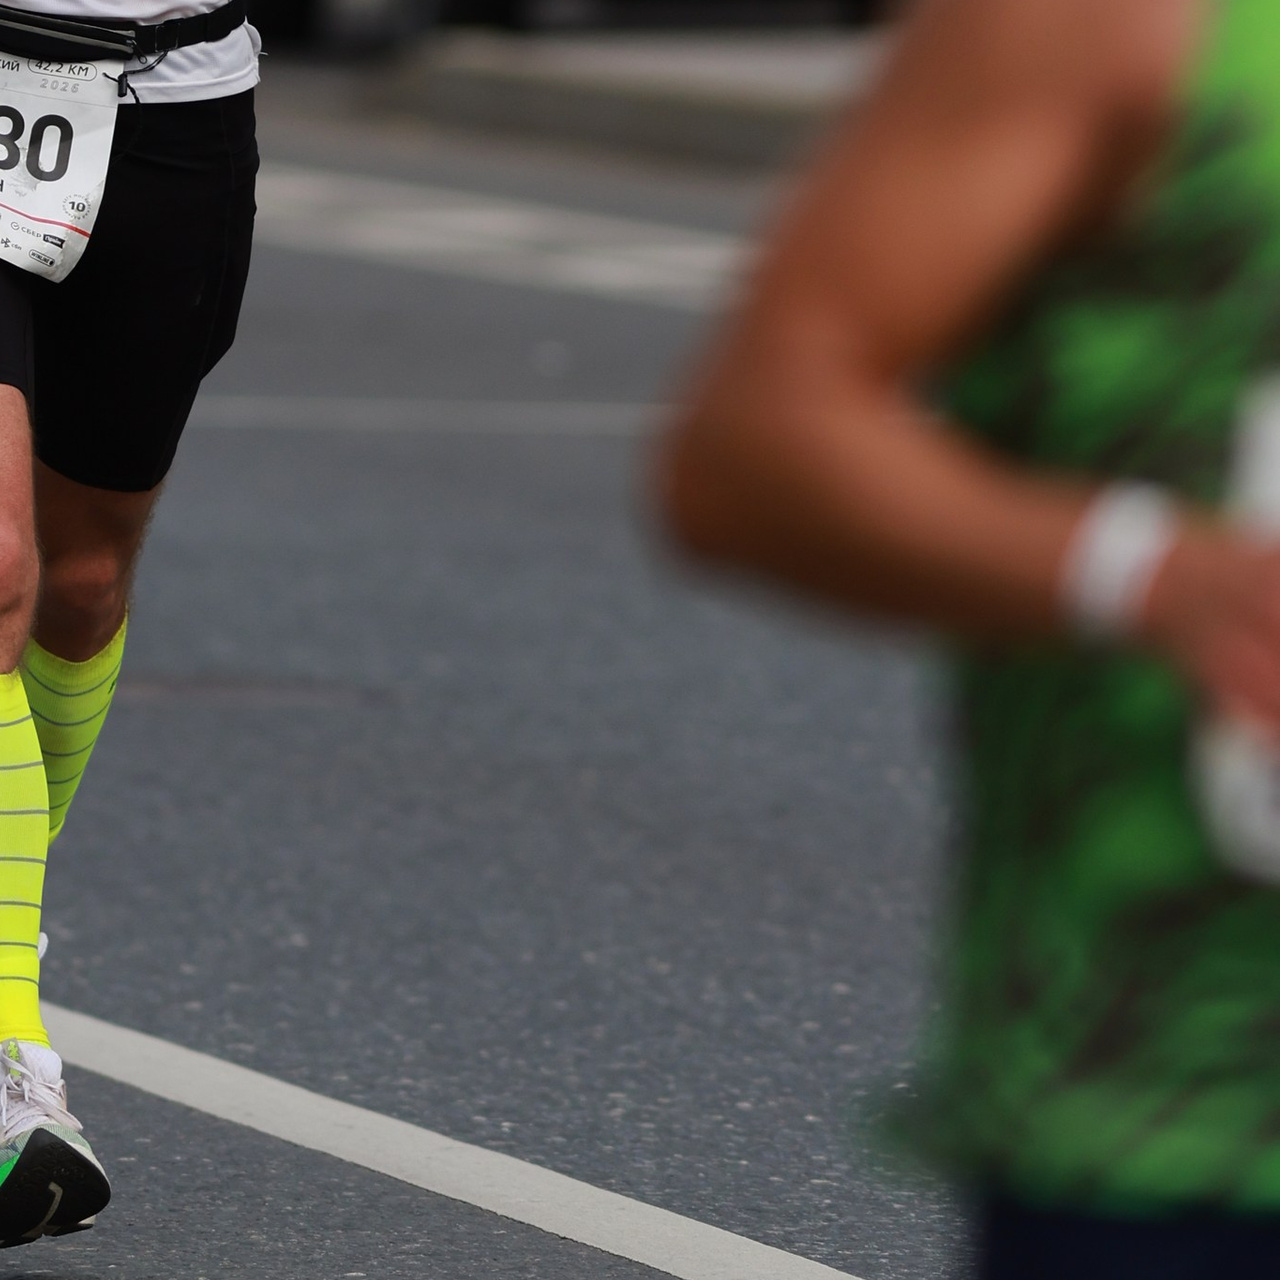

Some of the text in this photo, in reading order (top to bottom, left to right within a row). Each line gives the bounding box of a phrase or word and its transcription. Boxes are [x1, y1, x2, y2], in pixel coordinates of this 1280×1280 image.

[35, 61, 89, 77] 42,2 КМ
[68, 201, 86, 212] 10
